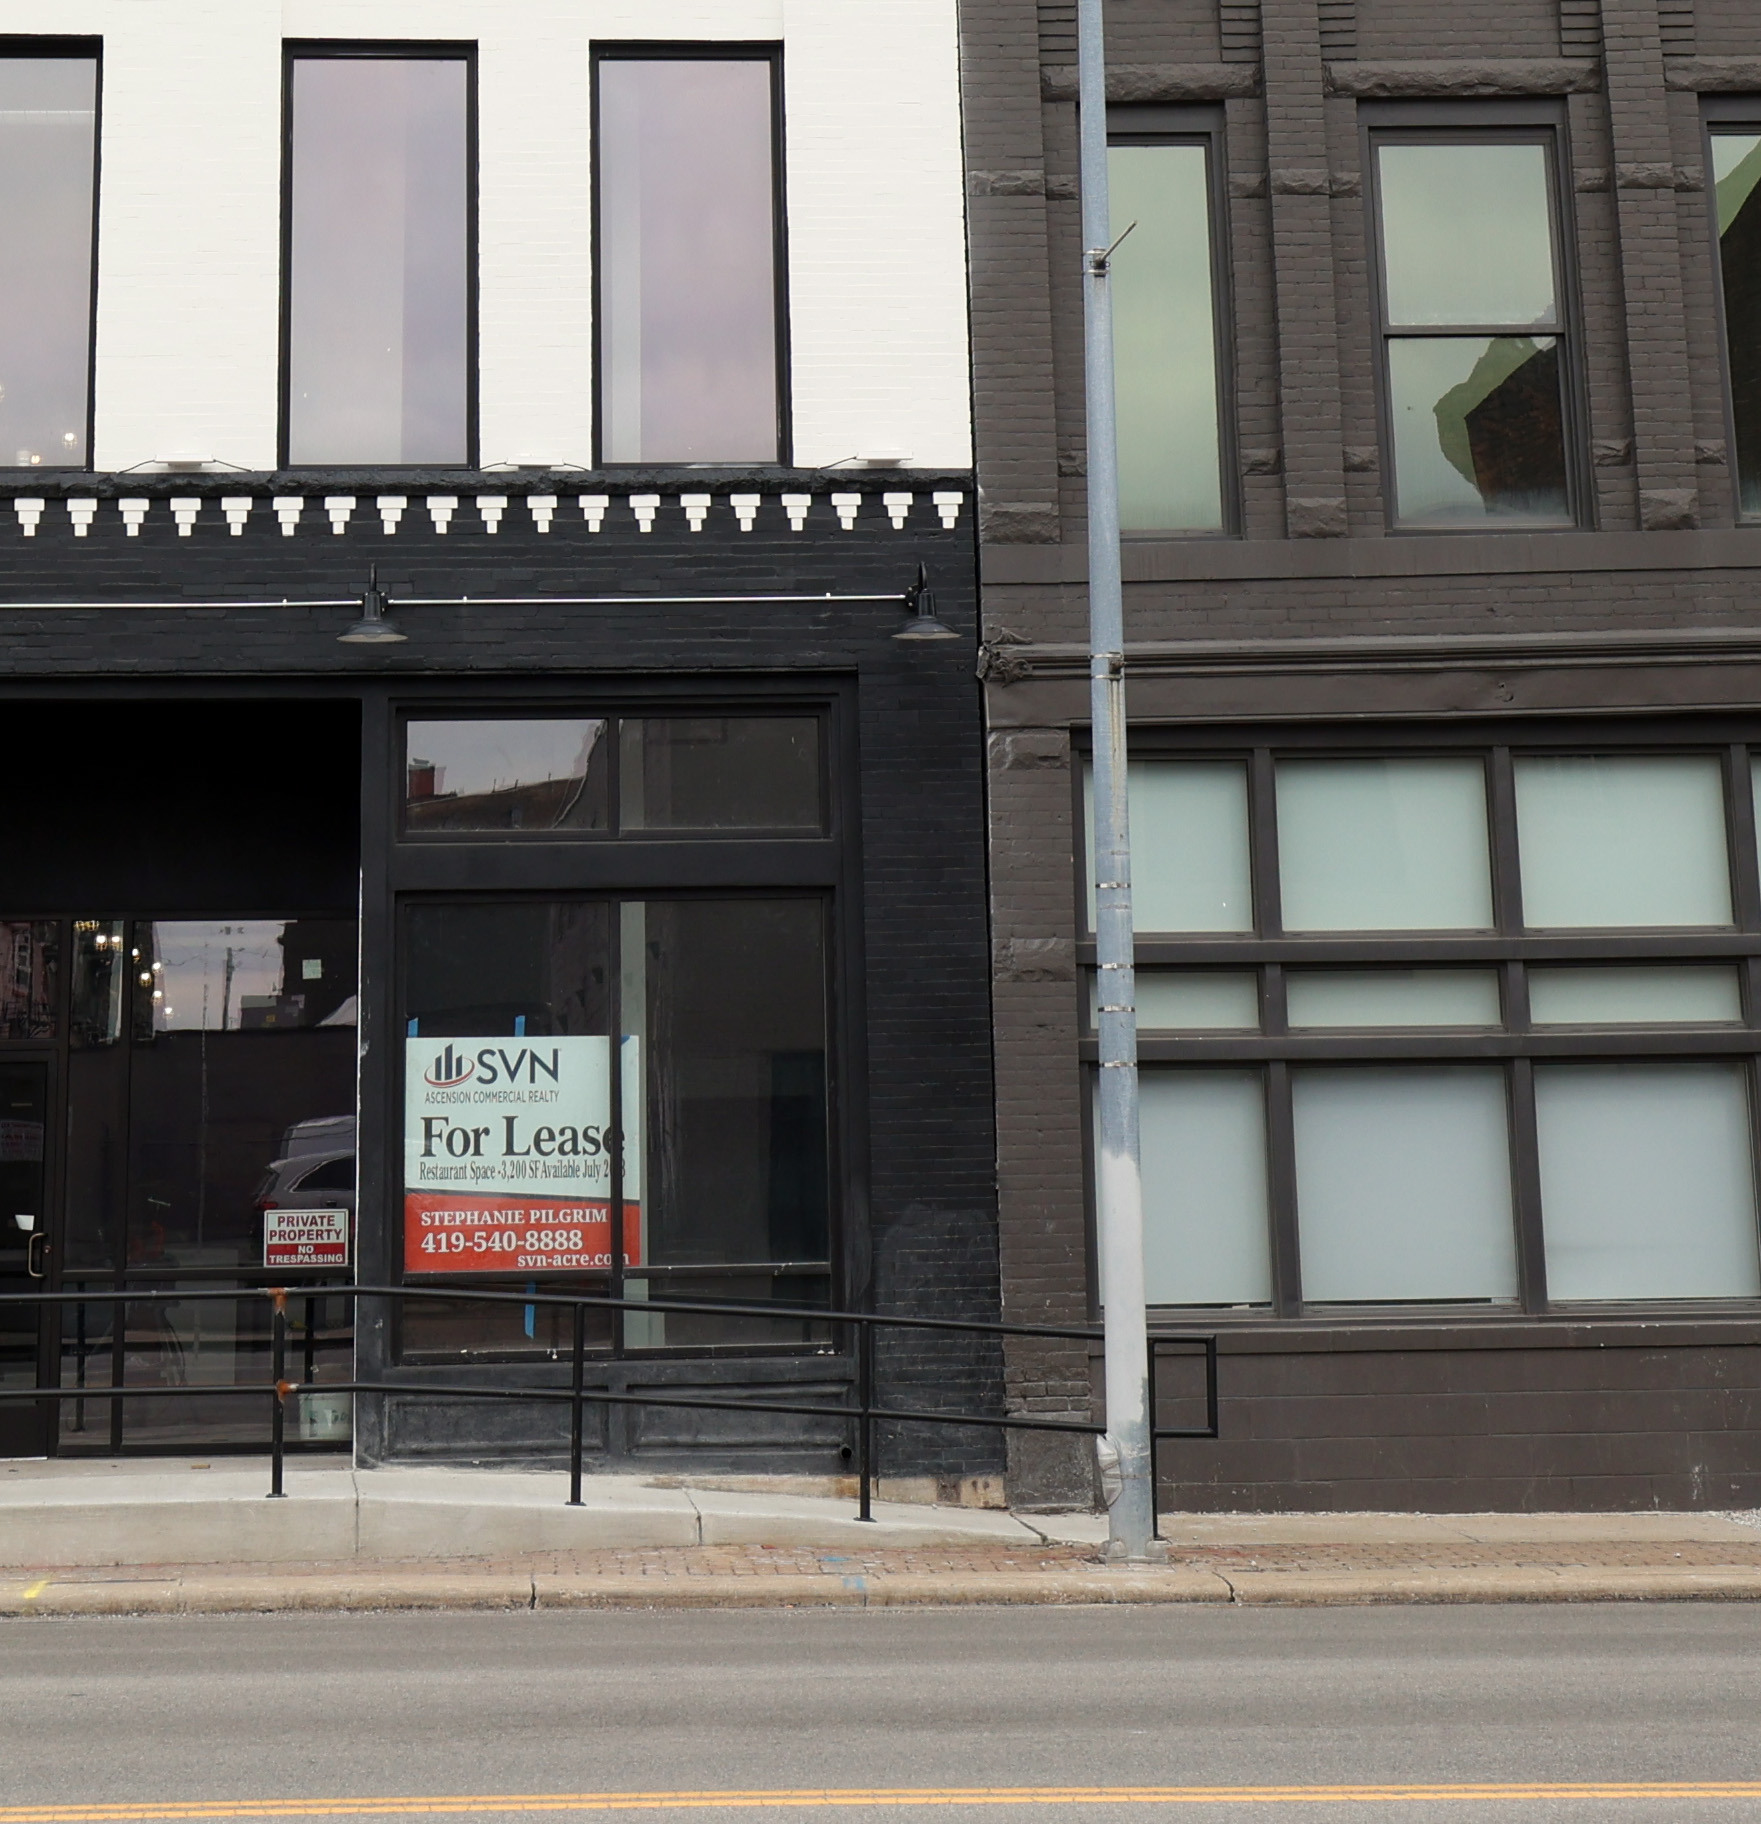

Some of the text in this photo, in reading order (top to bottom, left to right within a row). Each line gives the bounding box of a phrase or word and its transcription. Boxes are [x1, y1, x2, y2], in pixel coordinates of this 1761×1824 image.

[476, 1048, 559, 1085] SVN
[424, 1090, 560, 1104] ASCENSION COMMERCIAL REALTY
[420, 1116, 490, 1157] For
[419, 1161, 467, 1180] Restaurant
[470, 1160, 496, 1185] Space
[541, 1159, 580, 1179] Available
[582, 1159, 601, 1183] July
[277, 1215, 335, 1227] PRIVATE
[421, 1208, 608, 1226] STEPHANIE PILGRIM
[269, 1229, 343, 1241] PROPERTY
[421, 1230, 584, 1253] 419-540-8888
[298, 1245, 314, 1254] NO
[269, 1254, 343, 1264] TRESPASSING
